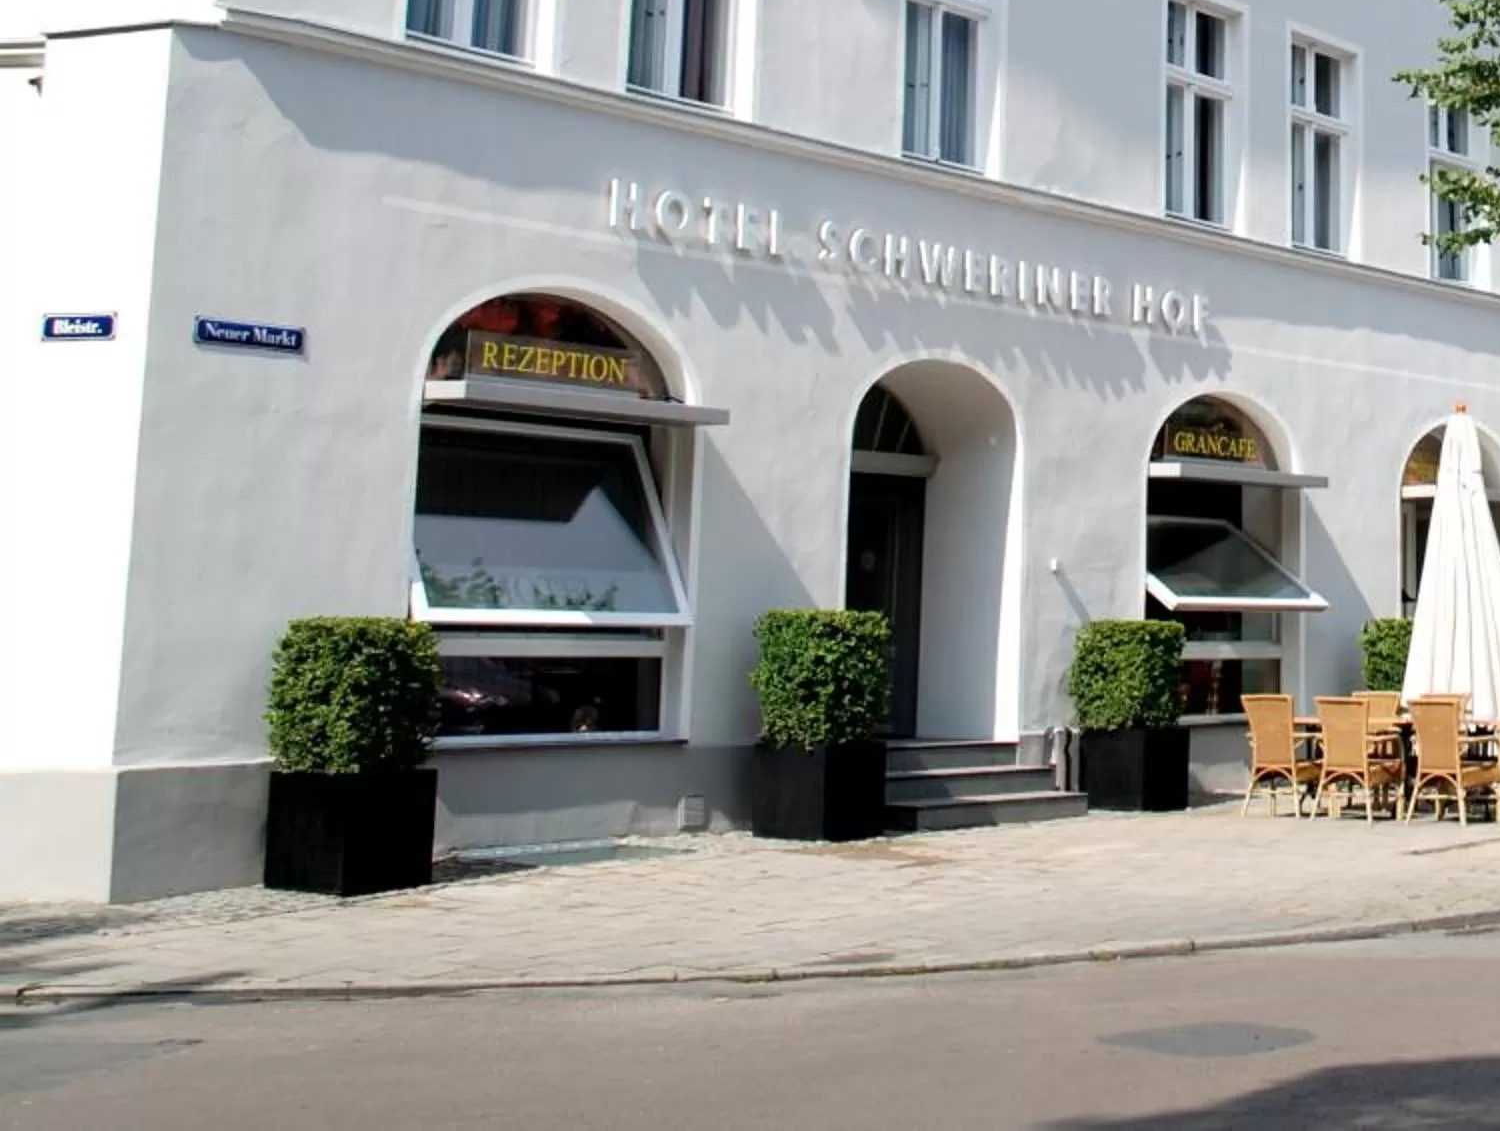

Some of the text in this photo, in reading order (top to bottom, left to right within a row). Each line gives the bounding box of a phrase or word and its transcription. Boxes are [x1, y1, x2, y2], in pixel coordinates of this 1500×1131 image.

[607, 178, 1210, 334] HOTEL SCHWERINER HOF
[205, 322, 297, 347] Neuer Markt
[482, 340, 629, 384] REZEPTION
